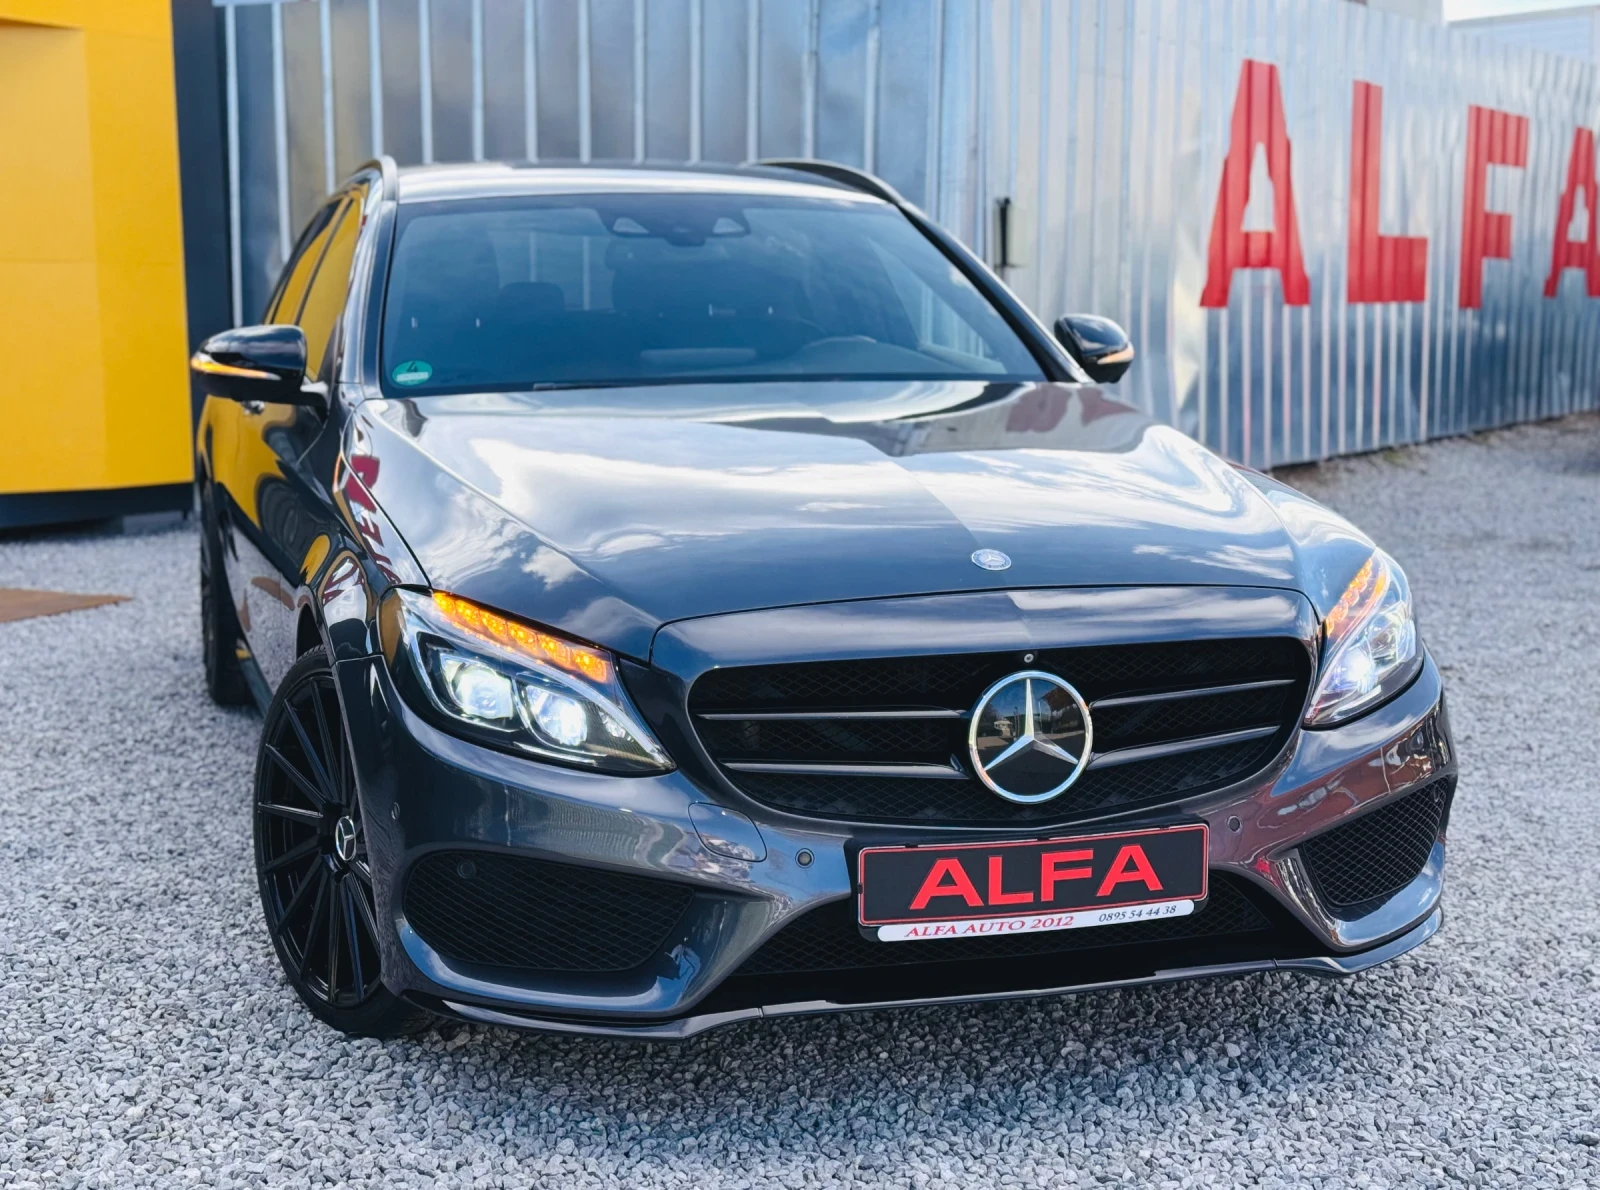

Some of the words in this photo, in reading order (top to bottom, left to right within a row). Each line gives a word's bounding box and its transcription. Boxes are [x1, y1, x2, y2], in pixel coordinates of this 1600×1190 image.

[1200, 58, 1600, 309] ALFA
[909, 844, 1164, 910] ALFA
[904, 924, 958, 938] ALFA
[961, 919, 1026, 935] AUTO
[1031, 915, 1074, 929] 2012
[1098, 911, 1127, 923] 0895
[1128, 909, 1143, 919] 54
[1145, 906, 1161, 917] 44
[1162, 904, 1177, 915] 38
